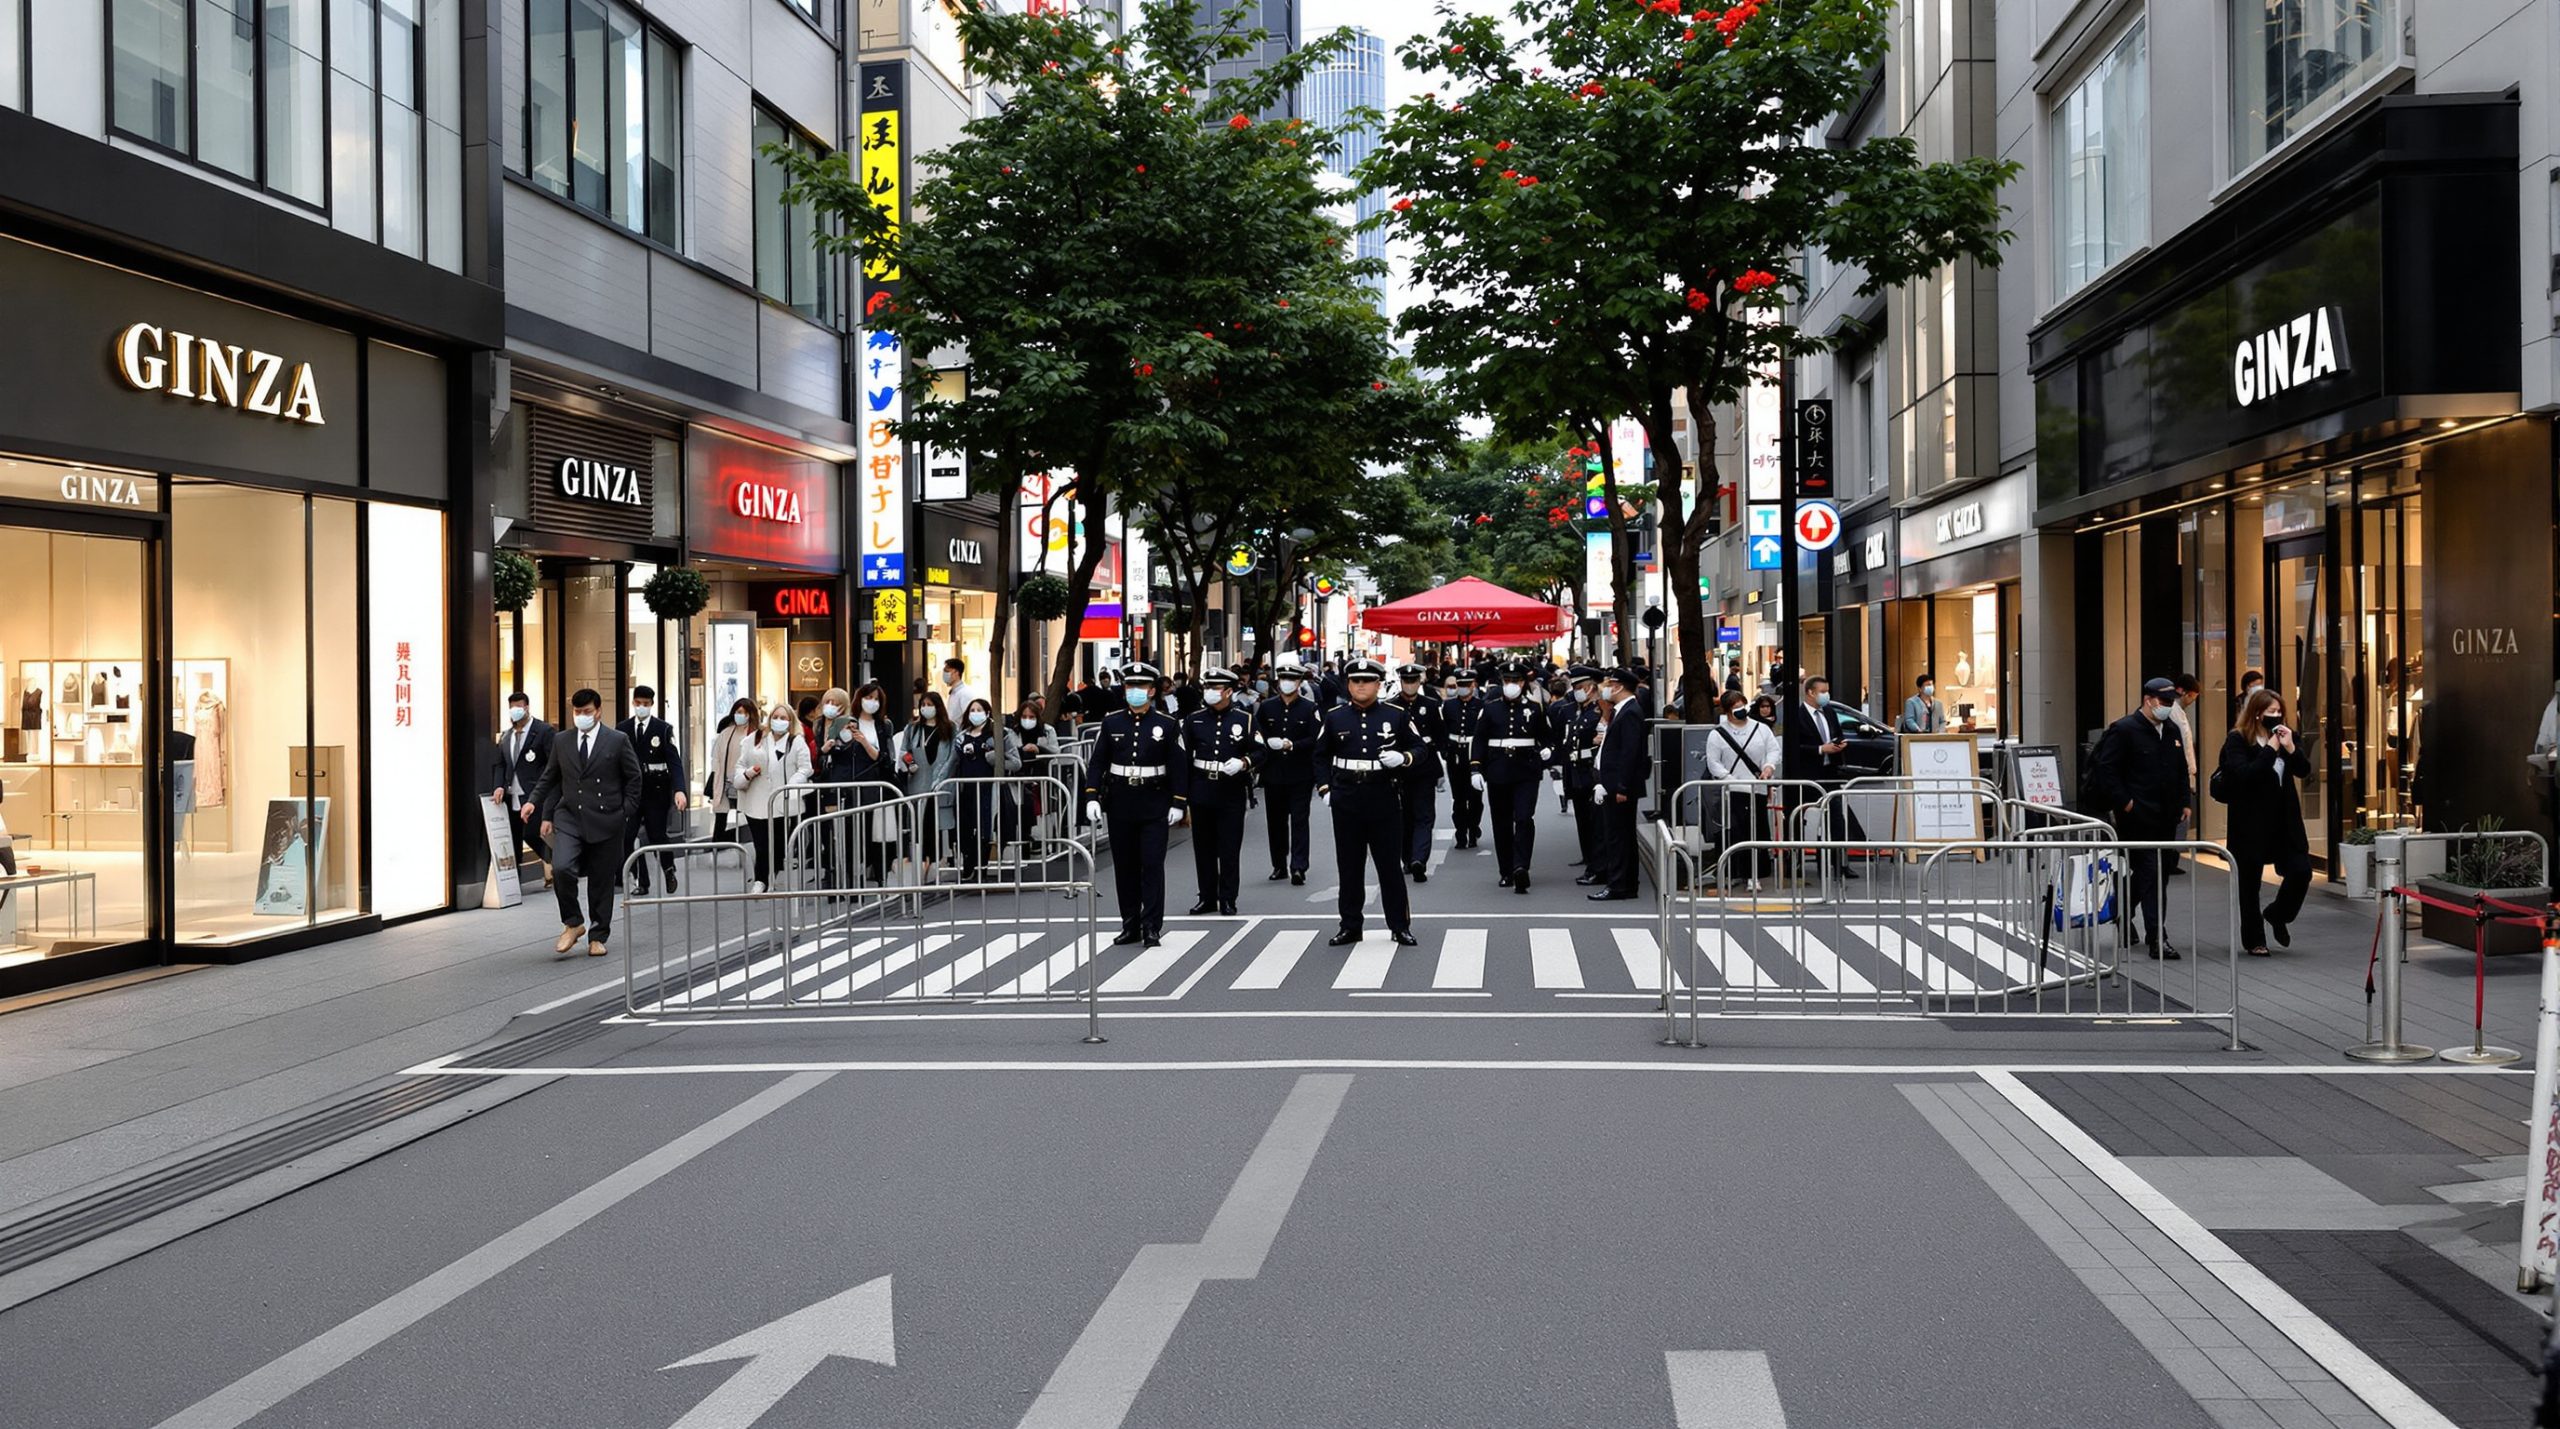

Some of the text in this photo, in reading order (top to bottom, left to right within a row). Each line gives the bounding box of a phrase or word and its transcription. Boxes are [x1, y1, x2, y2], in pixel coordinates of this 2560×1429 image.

[119, 322, 325, 425] GINZA
[2235, 306, 2338, 406] GINZA
[60, 475, 140, 505] GINZA
[561, 457, 641, 505] GINZA
[737, 481, 802, 524] GINZA
[1417, 611, 1460, 621] GINZA
[2452, 628, 2519, 655] GINZA
